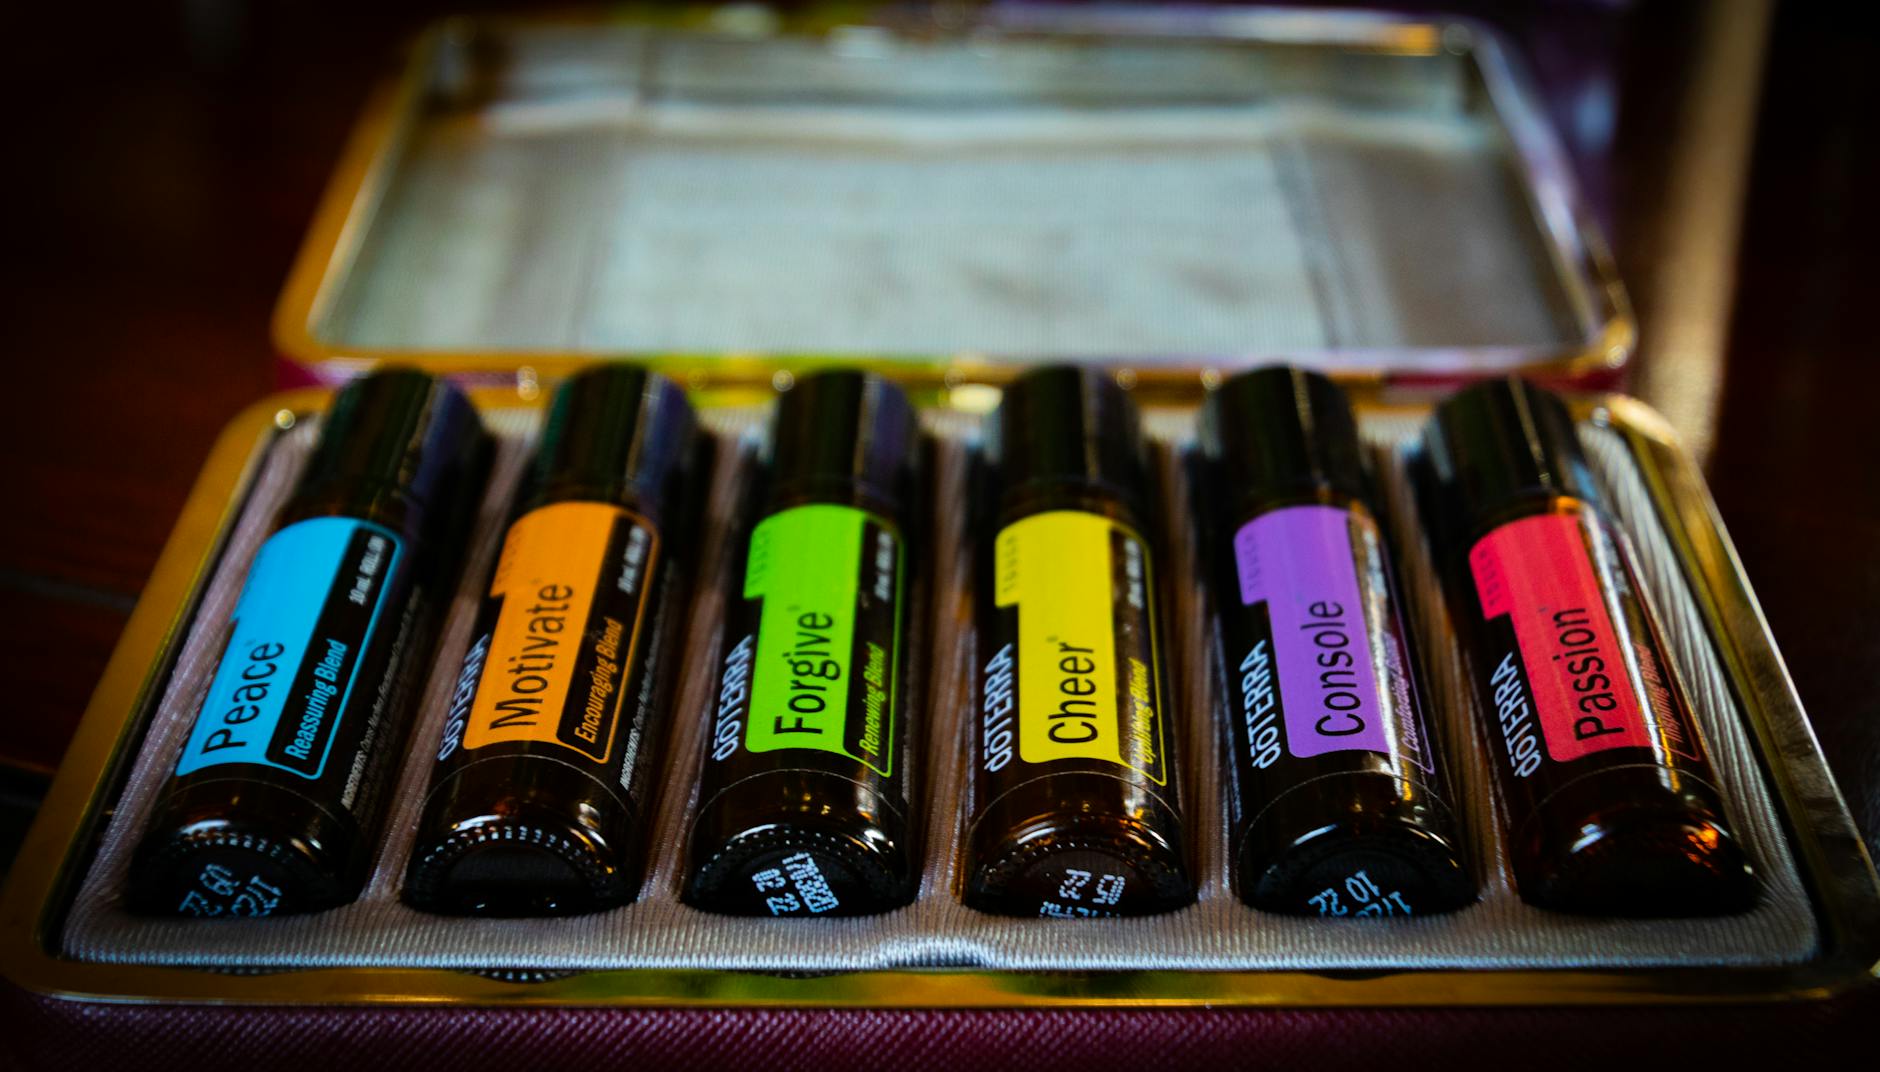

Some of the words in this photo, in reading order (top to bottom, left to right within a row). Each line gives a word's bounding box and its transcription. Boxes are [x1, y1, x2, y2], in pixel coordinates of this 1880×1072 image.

[489, 584, 574, 731] Motivate
[595, 616, 622, 660] Blend
[774, 611, 841, 735] Forgive
[863, 641, 884, 687] Blend
[1300, 600, 1365, 737] Console
[1553, 607, 1625, 741] Passion
[201, 641, 285, 754] Peace
[284, 678, 338, 760] Reassuring
[314, 638, 348, 682] Blend
[574, 656, 618, 744] Encouraging
[859, 682, 886, 756] Renewing
[1048, 641, 1098, 744] Cheer
[752, 868, 786, 892] 02
[766, 892, 800, 916] 22
[1059, 868, 1092, 900] 22
[1092, 874, 1125, 905] 05
[1346, 869, 1380, 903] 10
